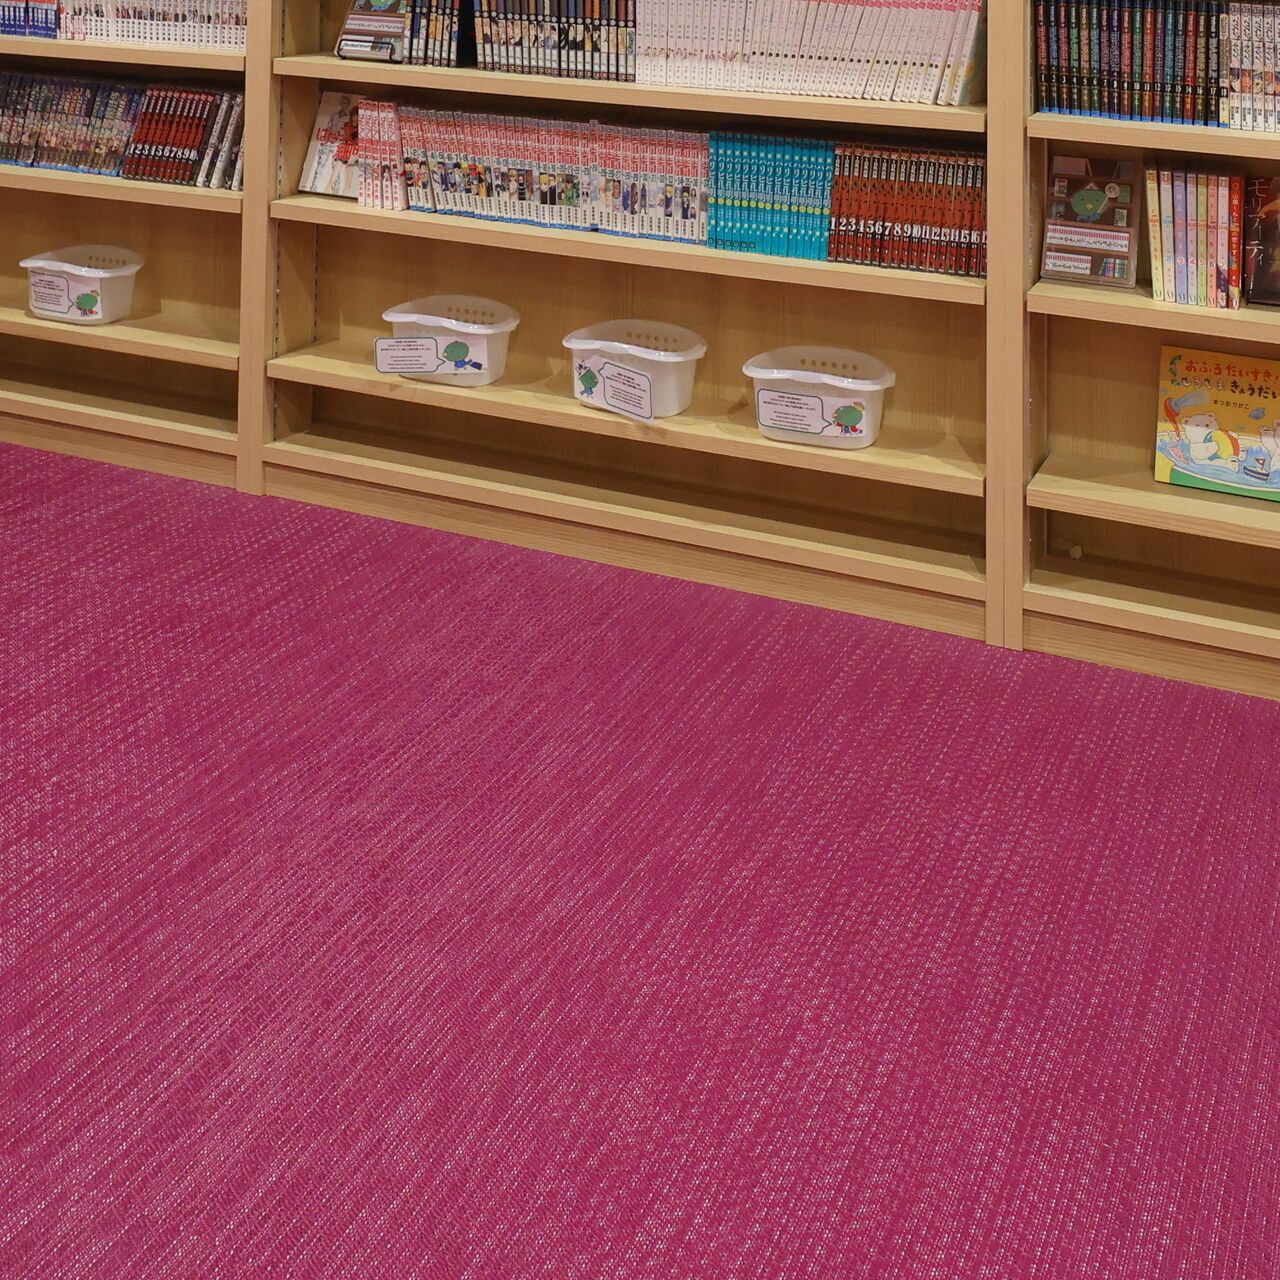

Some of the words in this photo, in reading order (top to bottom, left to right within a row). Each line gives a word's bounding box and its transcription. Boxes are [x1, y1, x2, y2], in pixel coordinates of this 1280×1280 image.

[857, 219, 865, 232] 4
[1246, 179, 1268, 266] モリアーティ
[903, 225, 911, 237] 9
[960, 231, 969, 243] 15
